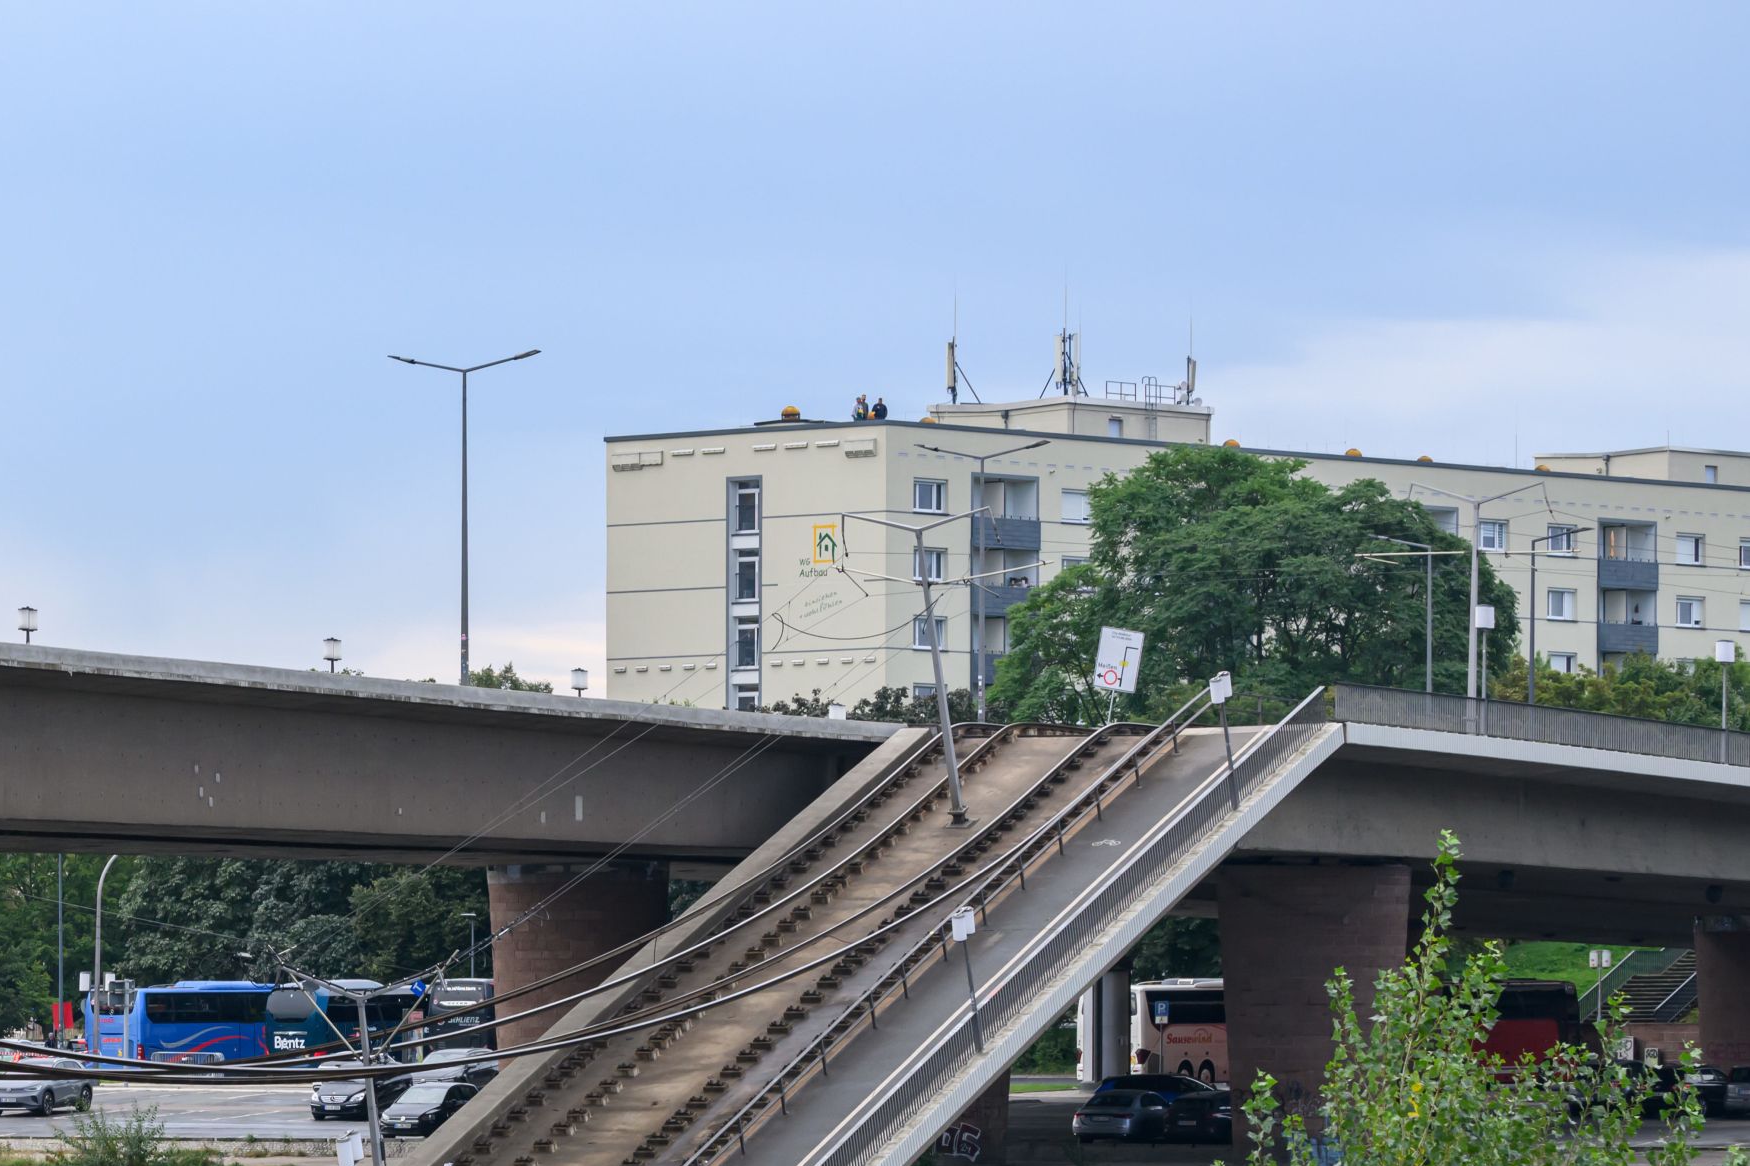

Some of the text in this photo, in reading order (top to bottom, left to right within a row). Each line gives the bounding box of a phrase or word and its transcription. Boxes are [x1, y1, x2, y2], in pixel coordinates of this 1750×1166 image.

[799, 558, 810, 566] WG
[799, 567, 828, 578] Aufbau
[1157, 1002, 1166, 1014] P
